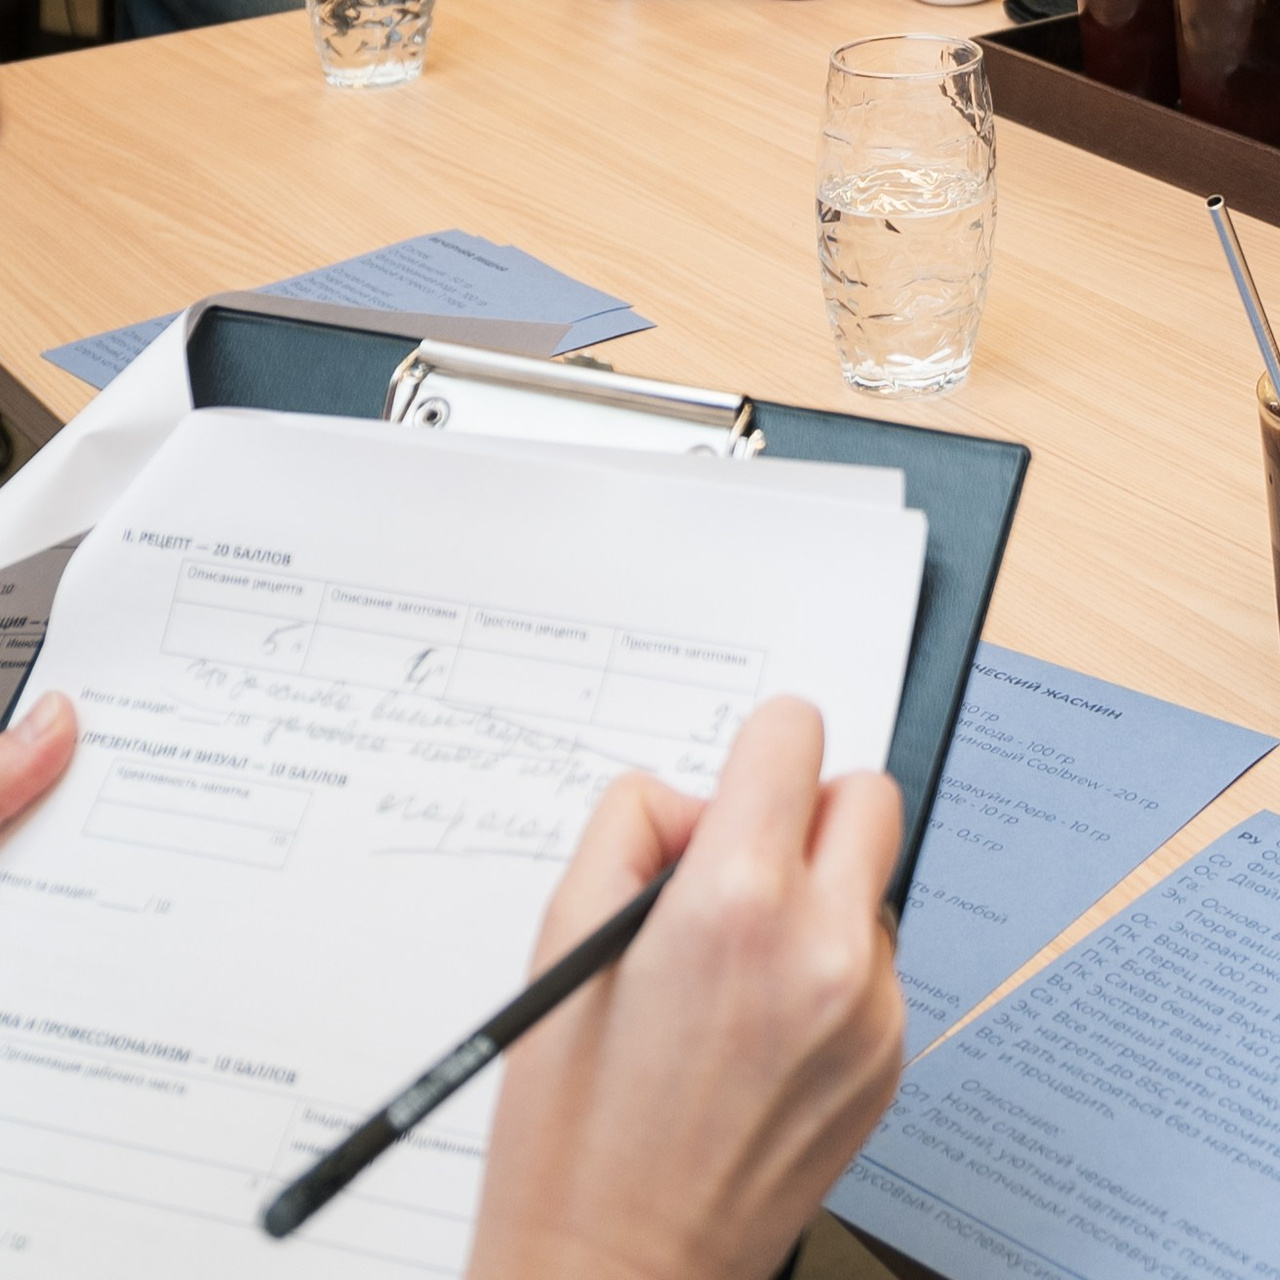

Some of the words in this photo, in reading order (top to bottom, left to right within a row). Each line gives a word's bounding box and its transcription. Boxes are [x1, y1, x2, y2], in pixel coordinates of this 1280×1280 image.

[138, 530, 193, 552] РЕЦЕПТ
[232, 545, 294, 567] БАЛЛОВ
[979, 710, 1000, 722] гр
[1040, 687, 1123, 719] ЖАСМИН
[81, 732, 177, 758] ПРЕЗЕНТАЦИЯ
[973, 724, 1014, 743] вода
[1025, 740, 1055, 757] 100
[1054, 752, 1075, 765] гр
[1025, 757, 1103, 790] Coolbrew
[1112, 787, 1138, 802] 20
[1137, 797, 1159, 810] гр
[978, 803, 998, 816] 10
[997, 812, 1019, 825] гр
[1069, 819, 1090, 833] 10
[1088, 829, 1111, 842] гр
[955, 828, 983, 843] 0,5
[981, 838, 1004, 851] гр
[931, 889, 946, 899] в
[944, 895, 1008, 925] любой
[1184, 908, 1237, 939] Пюре
[1200, 897, 1272, 935] Основа
[1152, 932, 1199, 962] Вода
[1212, 961, 1245, 982] 100
[1244, 979, 1269, 994] гр
[1161, 920, 1250, 964] Экстракт
[1119, 957, 1171, 988] Бобы
[1173, 984, 1225, 1016] тонка
[1136, 945, 1197, 983] Перец
[1198, 977, 1271, 1016] пипали
[1077, 983, 1170, 1029] Экстракт
[1168, 1026, 1279, 1085] ванильный
[1103, 971, 1159, 1003] Сахар
[1160, 999, 1222, 1036] белый
[1235, 1034, 1270, 1057] 140
[1033, 1025, 1105, 1066] нагреть
[1103, 1062, 1134, 1080] до
[1134, 1075, 1174, 1100] 85С
[1051, 1009, 1088, 1034] Все
[1088, 1030, 1215, 1099] ингредиенты
[1062, 996, 1165, 1050] Копченый
[1167, 1046, 1203, 1069] чай
[1203, 1065, 1242, 1089] Сяо
[1011, 1038, 1056, 1064] дать
[1058, 1060, 1165, 1119] настояться
[1164, 1113, 1201, 1138] без
